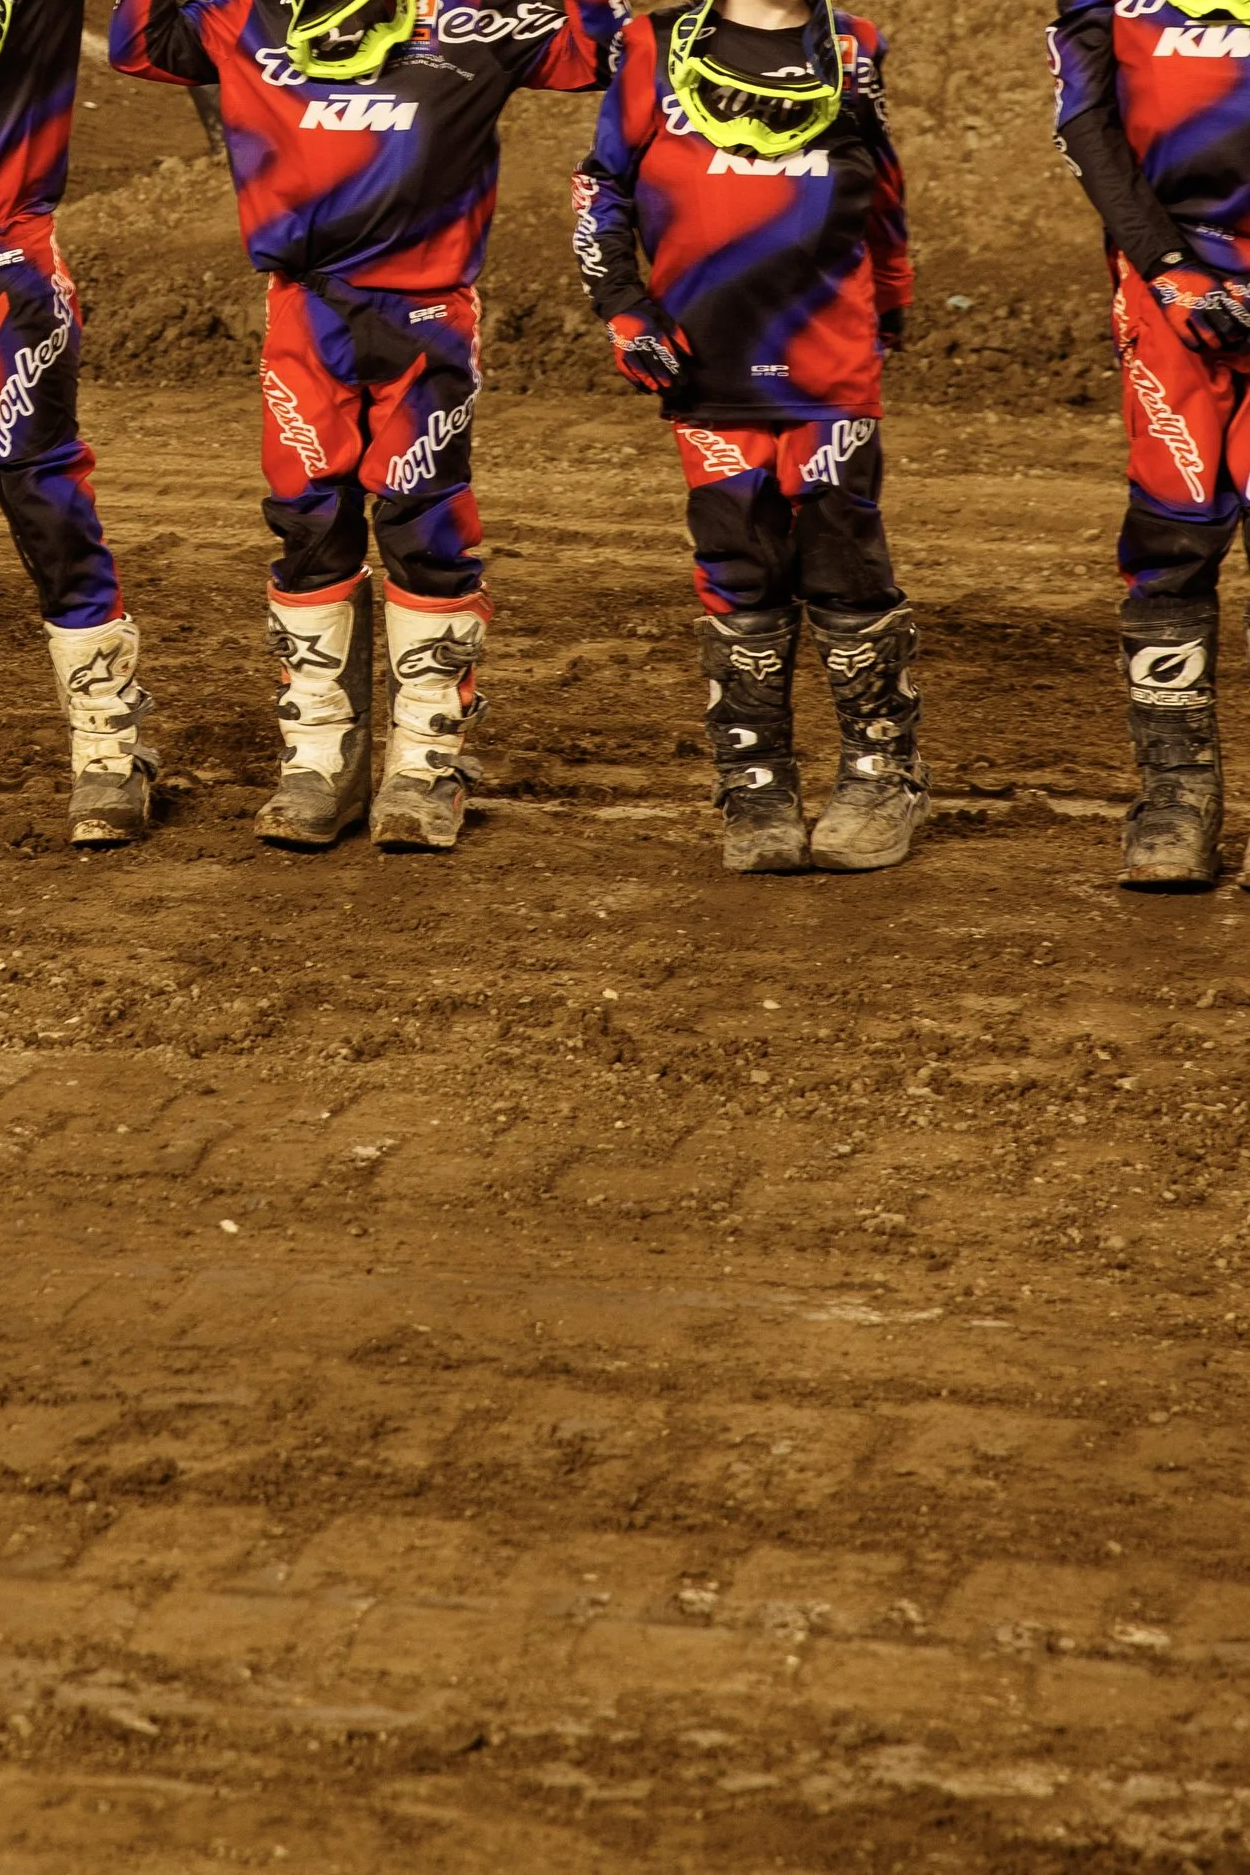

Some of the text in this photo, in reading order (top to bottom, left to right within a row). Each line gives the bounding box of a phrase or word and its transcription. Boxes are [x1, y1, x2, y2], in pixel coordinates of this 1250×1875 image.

[298, 93, 420, 131] KTM
[408, 304, 447, 319] GP
[409, 311, 448, 325] PRO
[750, 364, 790, 372] GP
